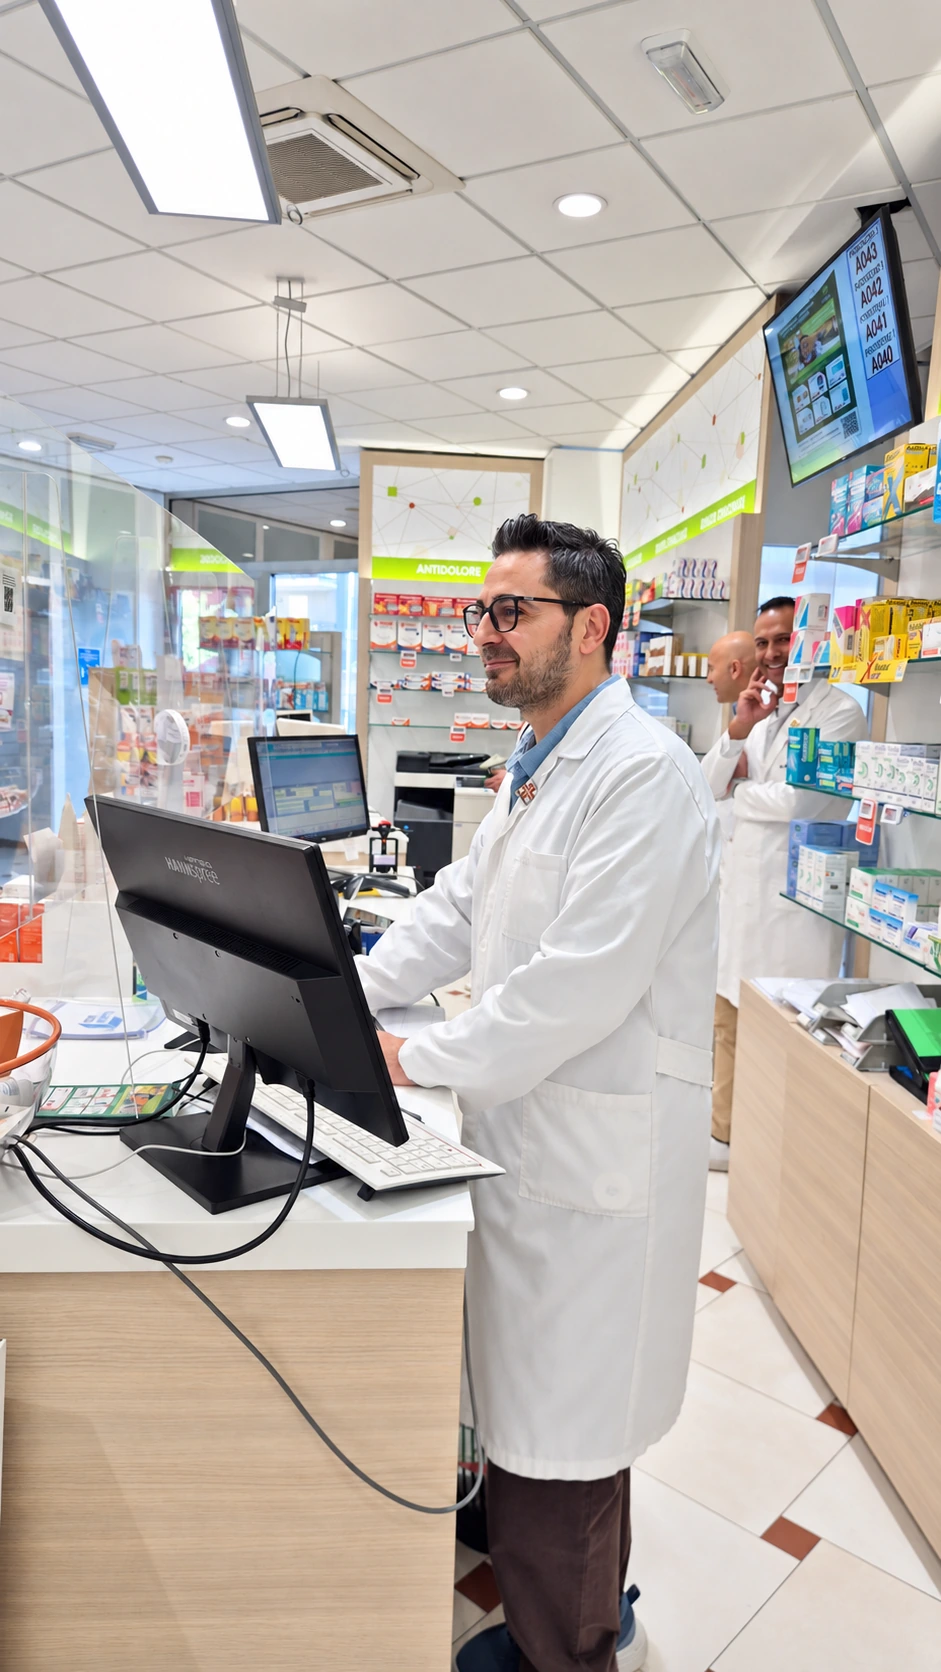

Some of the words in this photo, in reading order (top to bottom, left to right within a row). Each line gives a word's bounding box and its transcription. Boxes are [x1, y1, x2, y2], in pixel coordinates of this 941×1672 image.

[855, 241, 878, 275] A043
[861, 276, 884, 309] A042
[866, 311, 888, 342] A041
[872, 345, 893, 374] A040
[416, 564, 481, 577] ANTIDOLORE
